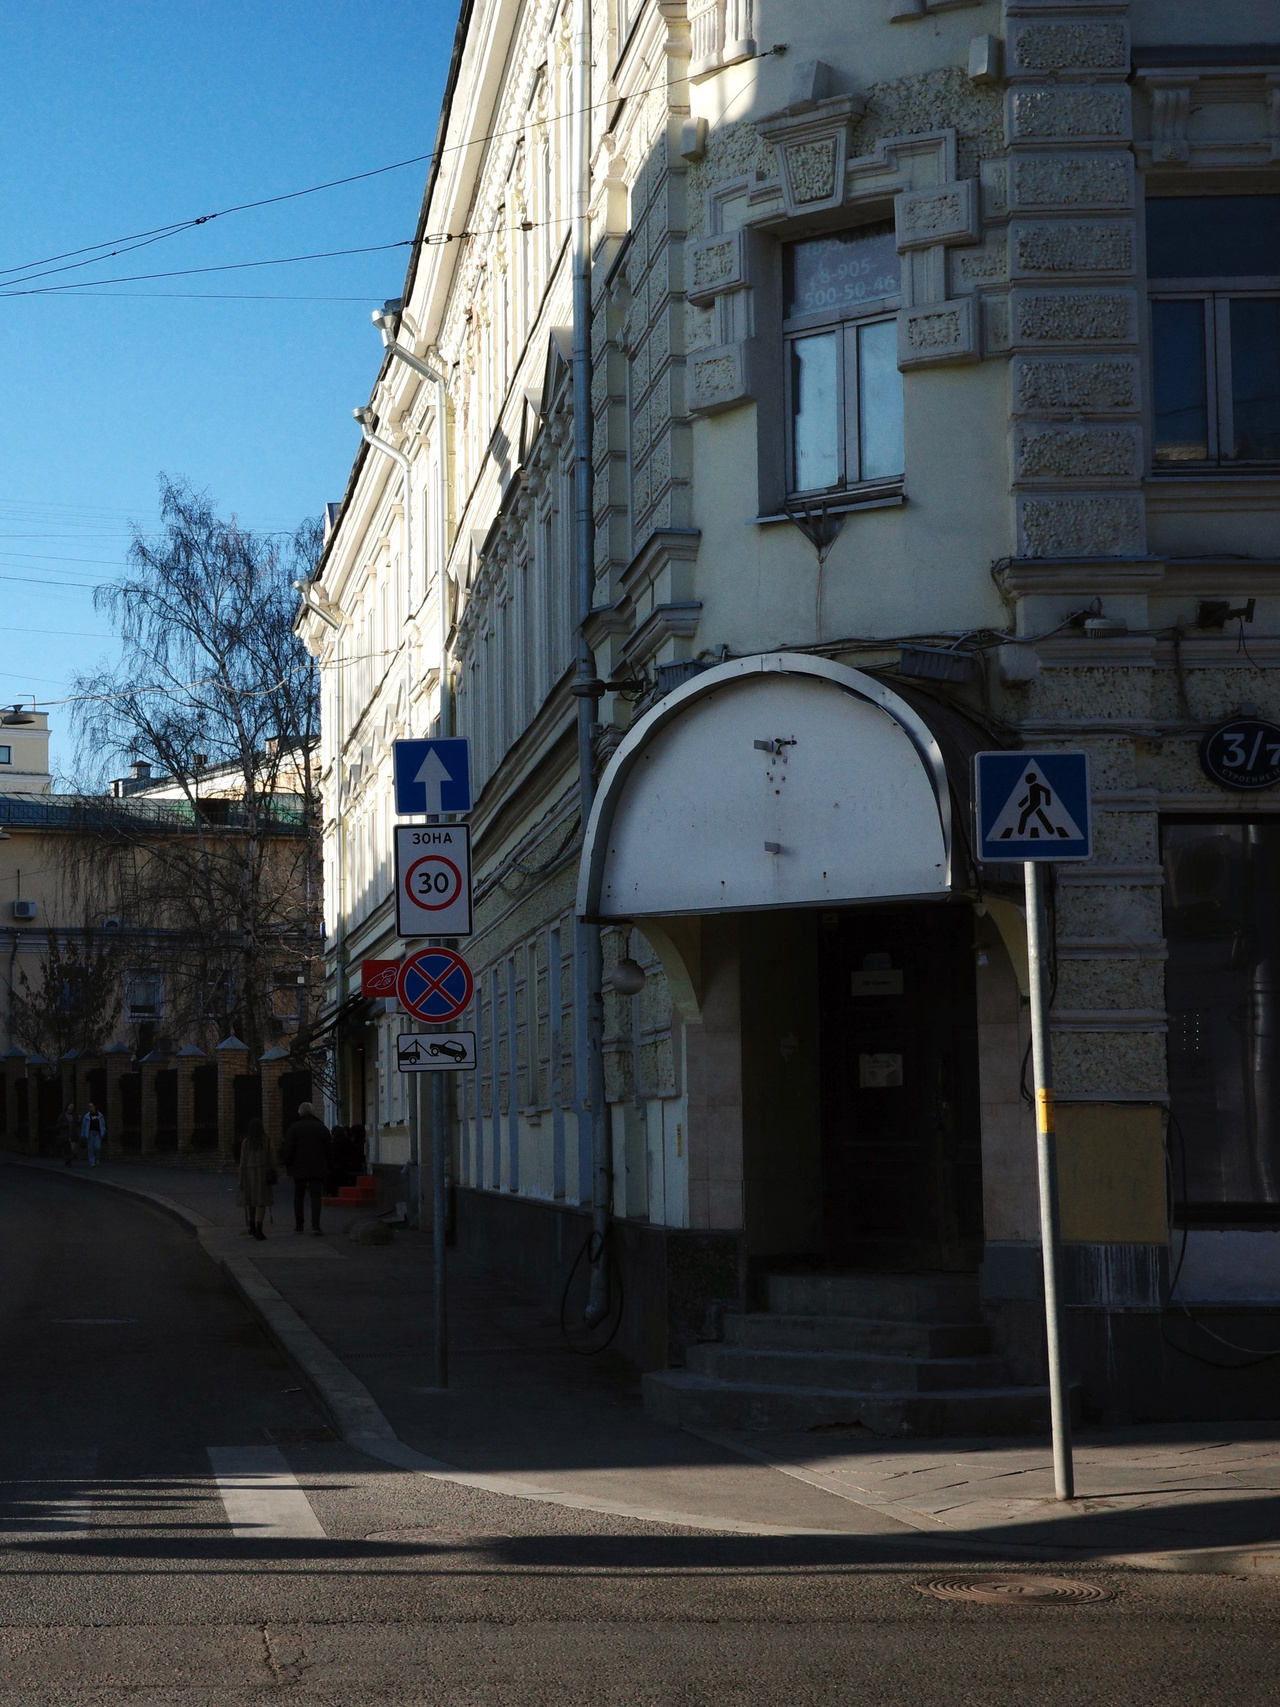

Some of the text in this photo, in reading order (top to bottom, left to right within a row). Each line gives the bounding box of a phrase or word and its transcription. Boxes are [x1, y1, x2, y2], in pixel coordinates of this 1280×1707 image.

[1222, 731, 1280, 770] 3/7
[1223, 769, 1272, 783] СТРОЕНИЕ
[412, 832, 452, 845] ЗОНА
[418, 872, 449, 894] 30
